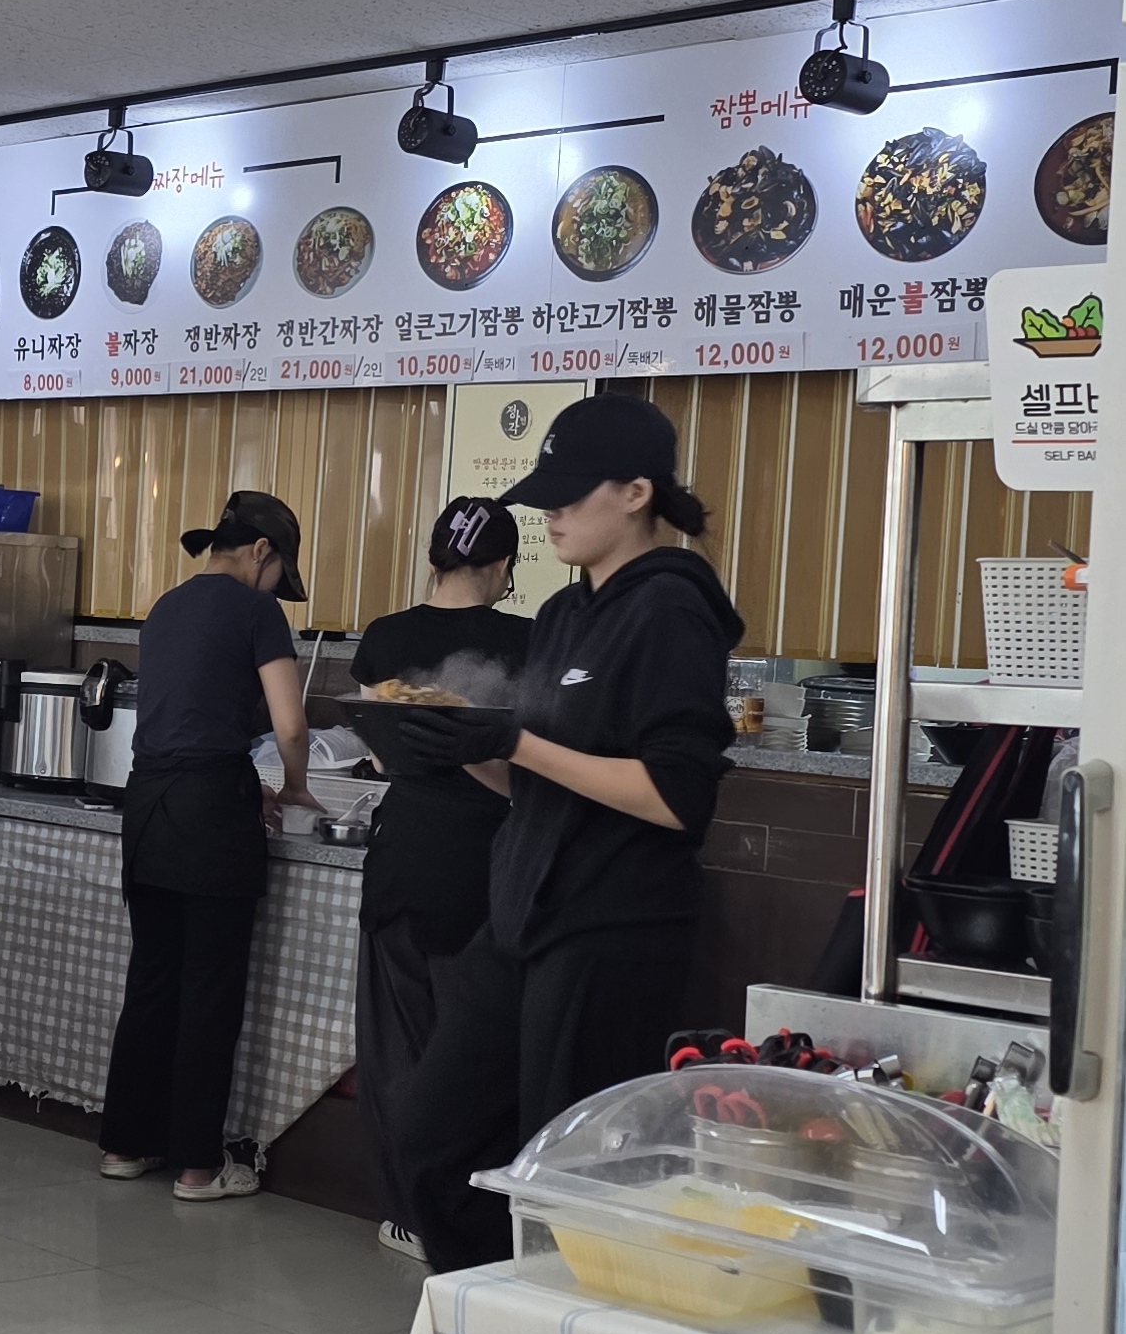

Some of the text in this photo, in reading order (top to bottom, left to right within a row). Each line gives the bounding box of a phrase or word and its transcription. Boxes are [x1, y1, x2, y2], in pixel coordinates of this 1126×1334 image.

[709, 86, 813, 129] 짬뽕메뉴
[152, 161, 225, 193] 짜장메뉴
[395, 306, 524, 342] 얼큰고기짬뽕
[532, 296, 678, 335] 하얀고기짬뽕
[694, 290, 802, 327] 해물짬뽕
[105, 328, 159, 357] 불짜장
[184, 321, 261, 353] 쟁반짜장
[276, 314, 384, 348] 쟁반간짜장
[14, 333, 82, 362] 유니짜장
[1015, 422, 1038, 435] 드실
[1044, 451, 1075, 461] SELF
